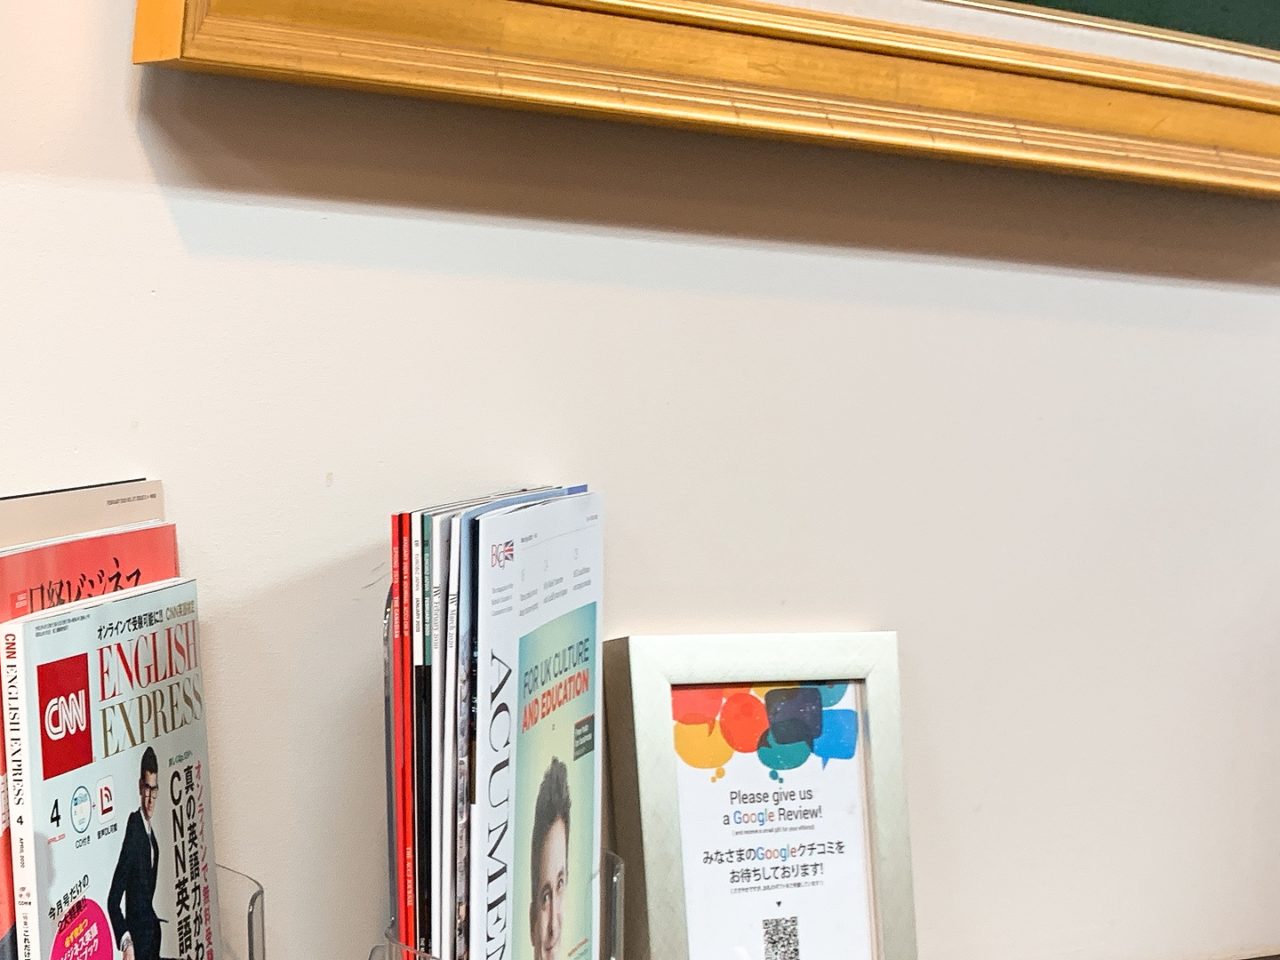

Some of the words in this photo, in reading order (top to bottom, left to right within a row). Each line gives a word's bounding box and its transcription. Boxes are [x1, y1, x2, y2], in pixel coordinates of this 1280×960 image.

[5, 633, 17, 660] CNN
[97, 620, 200, 703] ENGLISH
[523, 664, 539, 699] FOR
[552, 637, 590, 679] CULTURE
[6, 664, 21, 732] ENGLISH
[44, 688, 87, 741] CNN
[99, 673, 205, 760] EXPRESS
[522, 697, 539, 735] AND
[540, 667, 590, 721] EDUCATION
[11, 737, 25, 806] EXPRESS
[50, 798, 62, 828] 4
[722, 813, 731, 826] a
[733, 807, 775, 826] Google
[778, 805, 823, 822] Review!
[730, 789, 770, 806] Please
[772, 787, 796, 806] give
[799, 788, 813, 800] us
[16, 815, 24, 826] 4
[702, 840, 846, 865] みなさまのGoogleクチコミを
[729, 862, 825, 884] お待ちしております!
[48, 874, 90, 921] 今月号だけの
